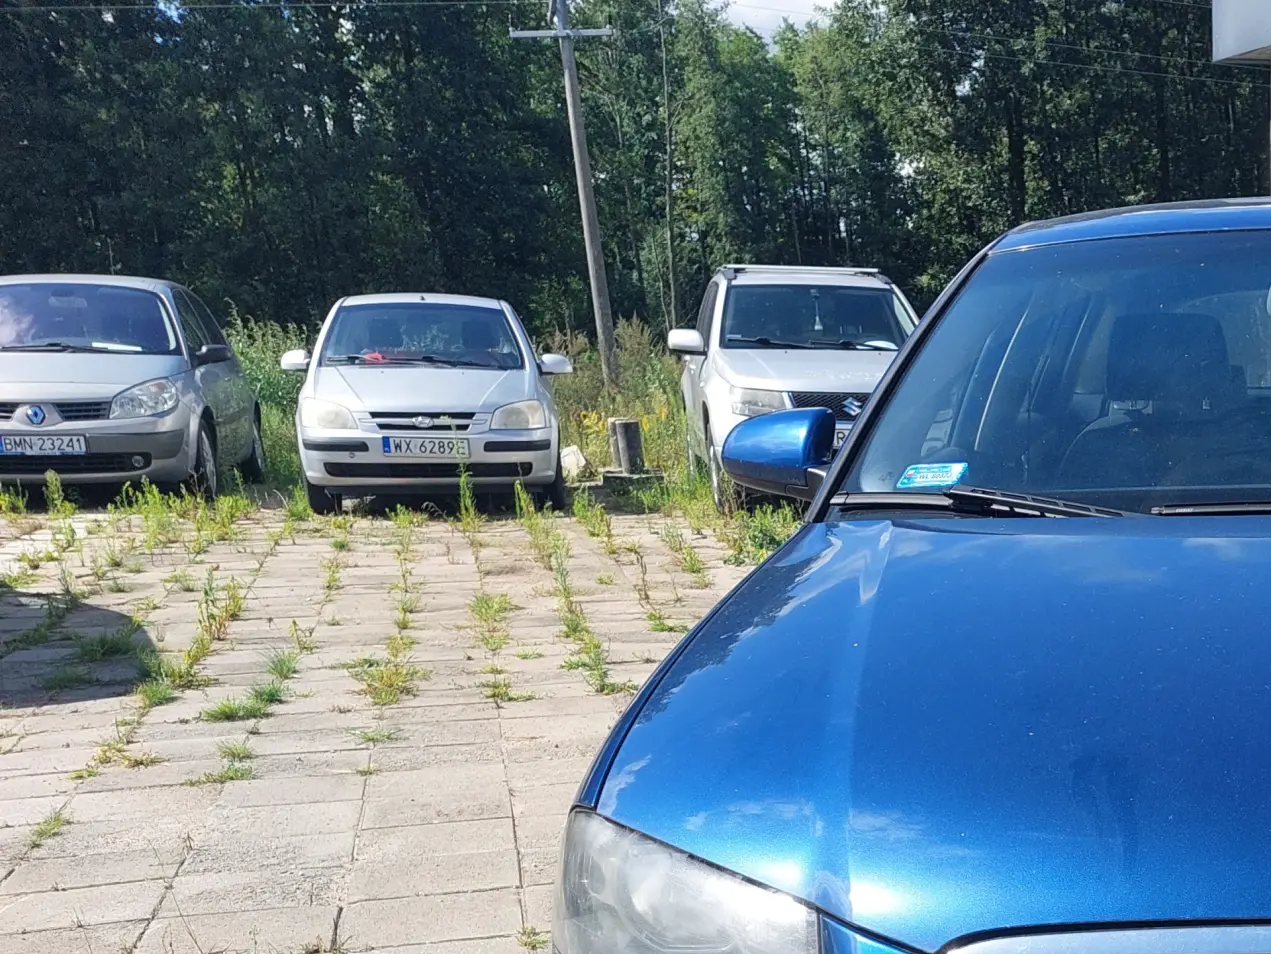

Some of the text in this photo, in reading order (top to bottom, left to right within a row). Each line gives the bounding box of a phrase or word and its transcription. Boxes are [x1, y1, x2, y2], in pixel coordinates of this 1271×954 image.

[4, 437, 82, 451] BMN 23241
[393, 438, 413, 453] WX
